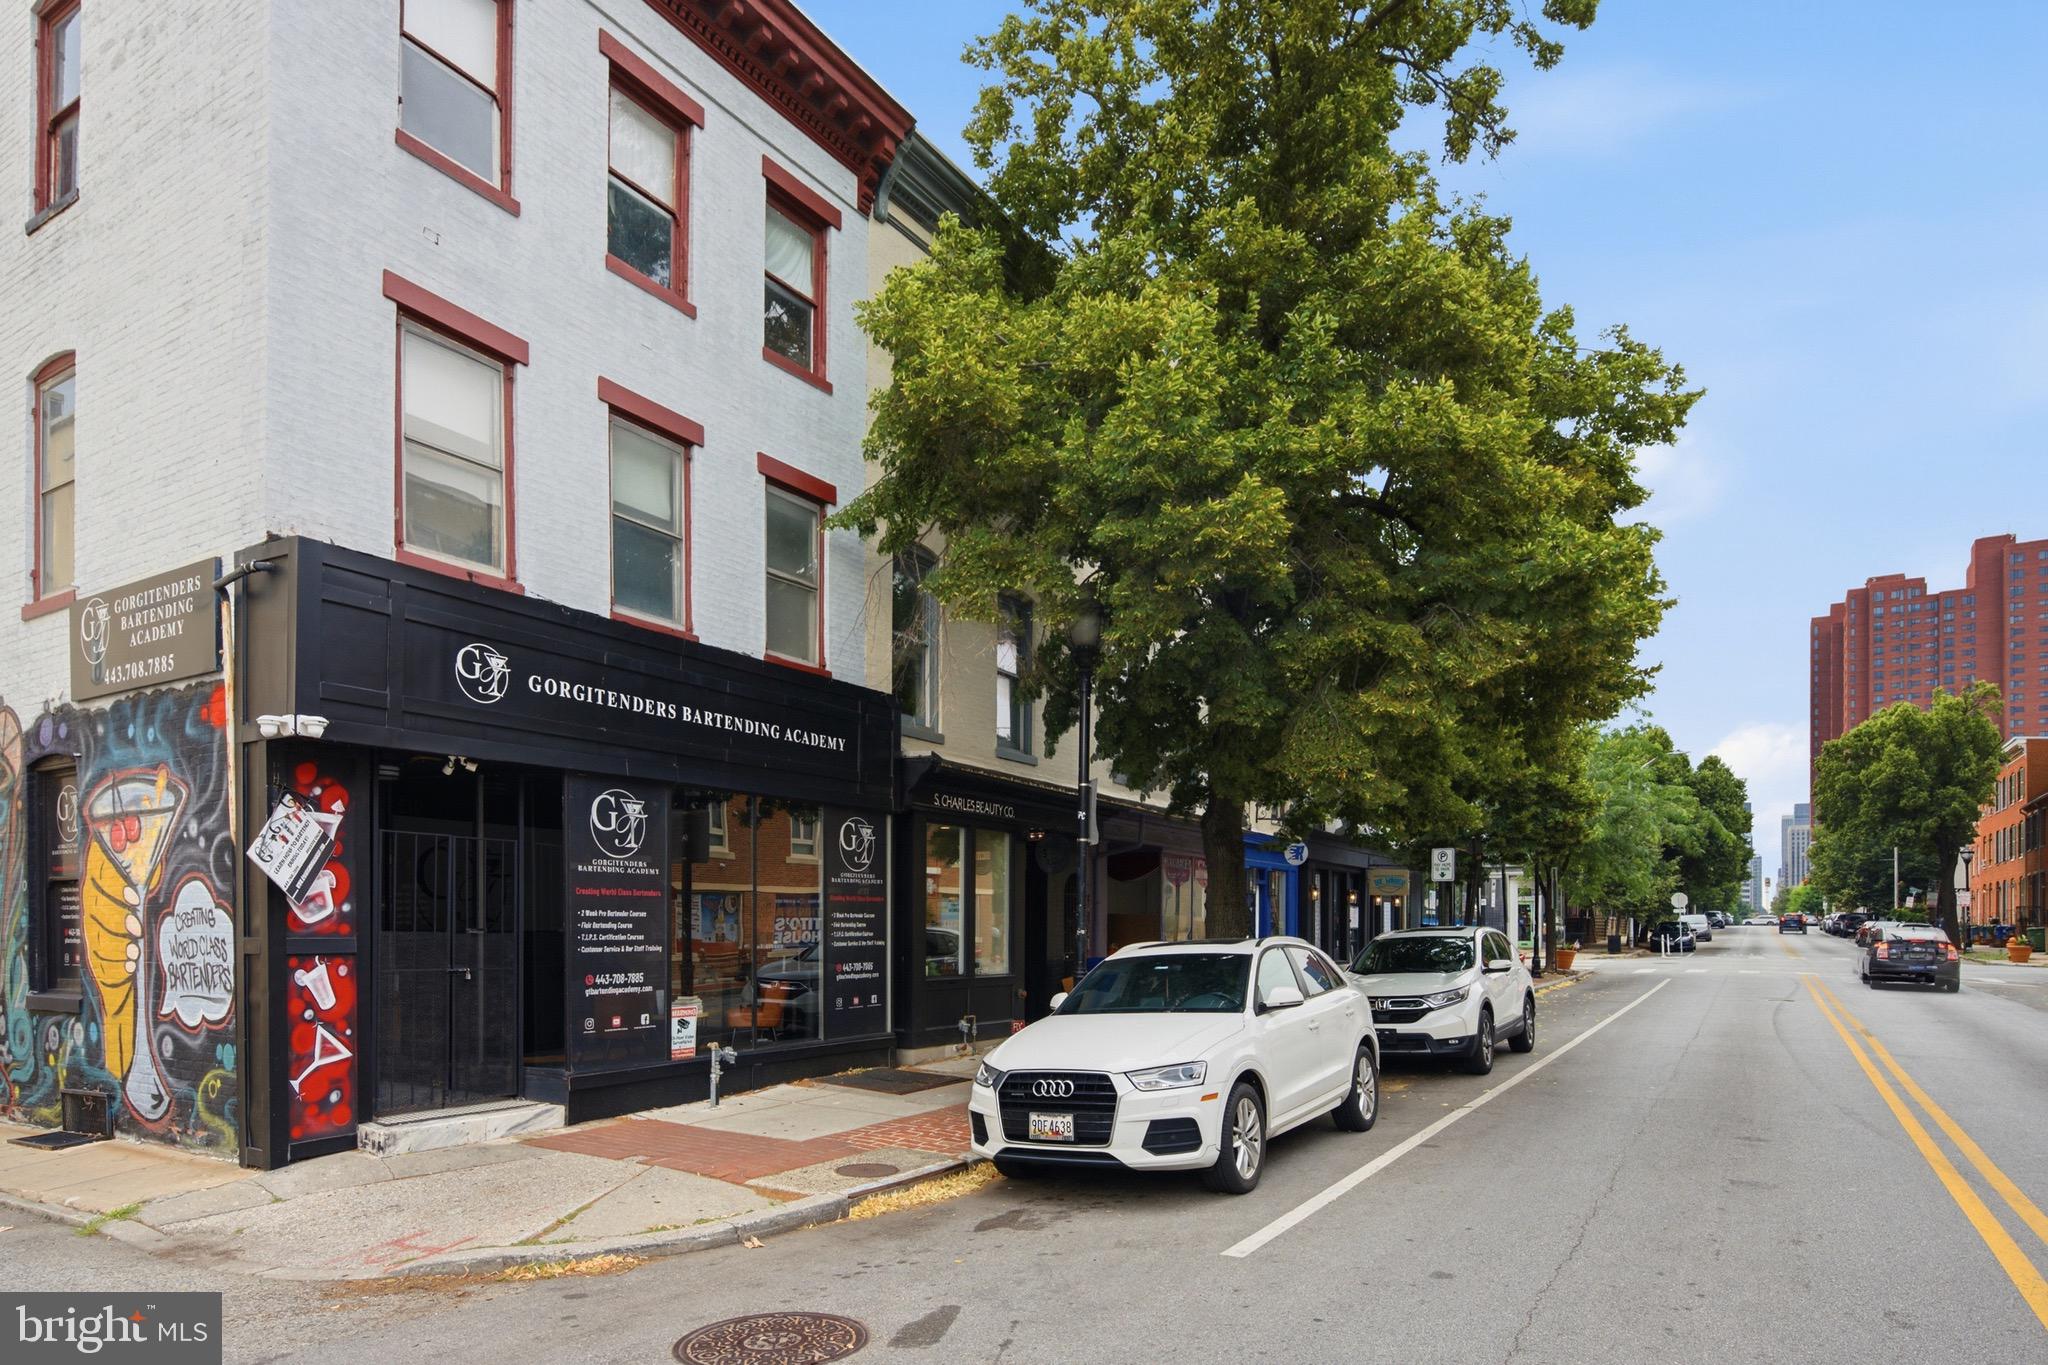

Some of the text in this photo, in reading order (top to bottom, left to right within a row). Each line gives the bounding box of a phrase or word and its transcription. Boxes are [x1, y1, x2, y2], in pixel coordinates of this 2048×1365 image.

[114, 575, 201, 614] GORGITENDERS
[121, 597, 194, 631] BARTENDING
[129, 619, 184, 647] ACADEMY
[104, 653, 175, 685] 443.708.7885
[528, 675, 846, 752] GORGITENDERS BARTENDING ACADEMY
[941, 794, 975, 813] CHARLES
[975, 800, 1003, 816] BEAUTY
[199, 935, 228, 963] CLASS
[168, 958, 232, 994] BARTENDERS
[595, 972, 645, 985] 443-708-7885
